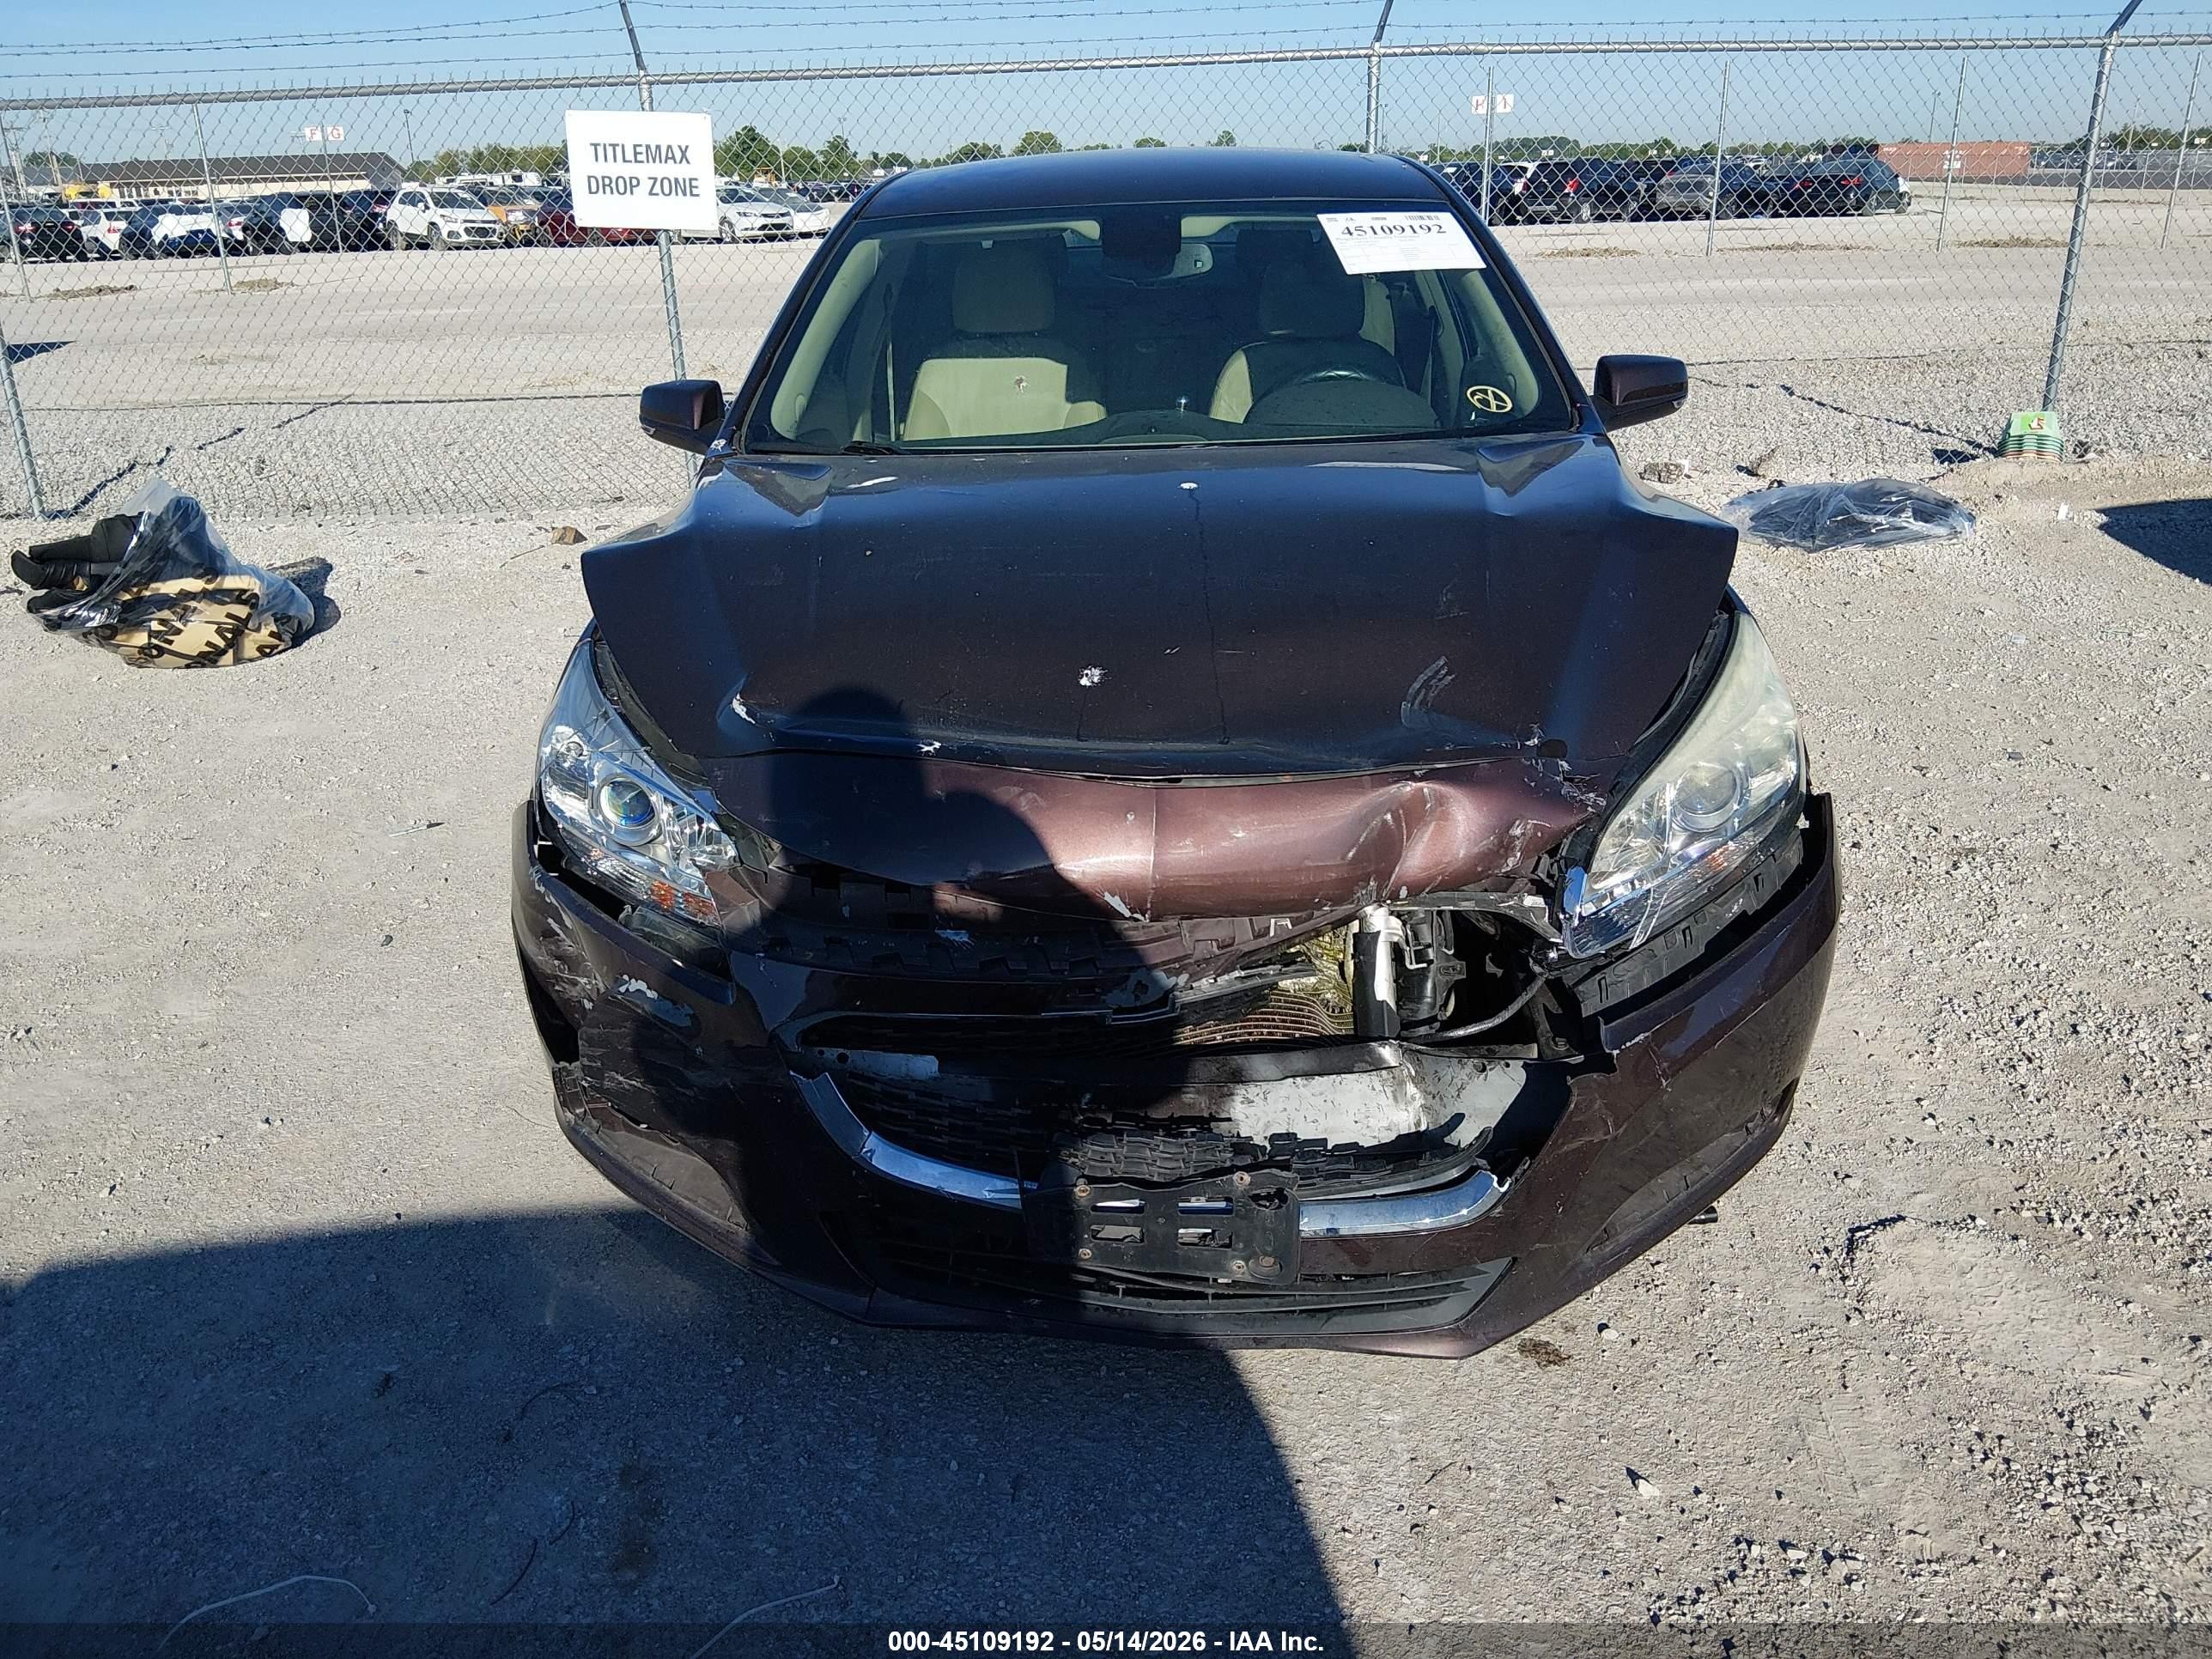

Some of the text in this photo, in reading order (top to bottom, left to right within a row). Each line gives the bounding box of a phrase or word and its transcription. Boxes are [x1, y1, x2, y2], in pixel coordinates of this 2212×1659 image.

[310, 129, 317, 139] F
[331, 128, 341, 139] G
[589, 143, 690, 164] TITLEMAX
[586, 175, 701, 197] DROP ZONE
[1341, 223, 1446, 237] 45109192
